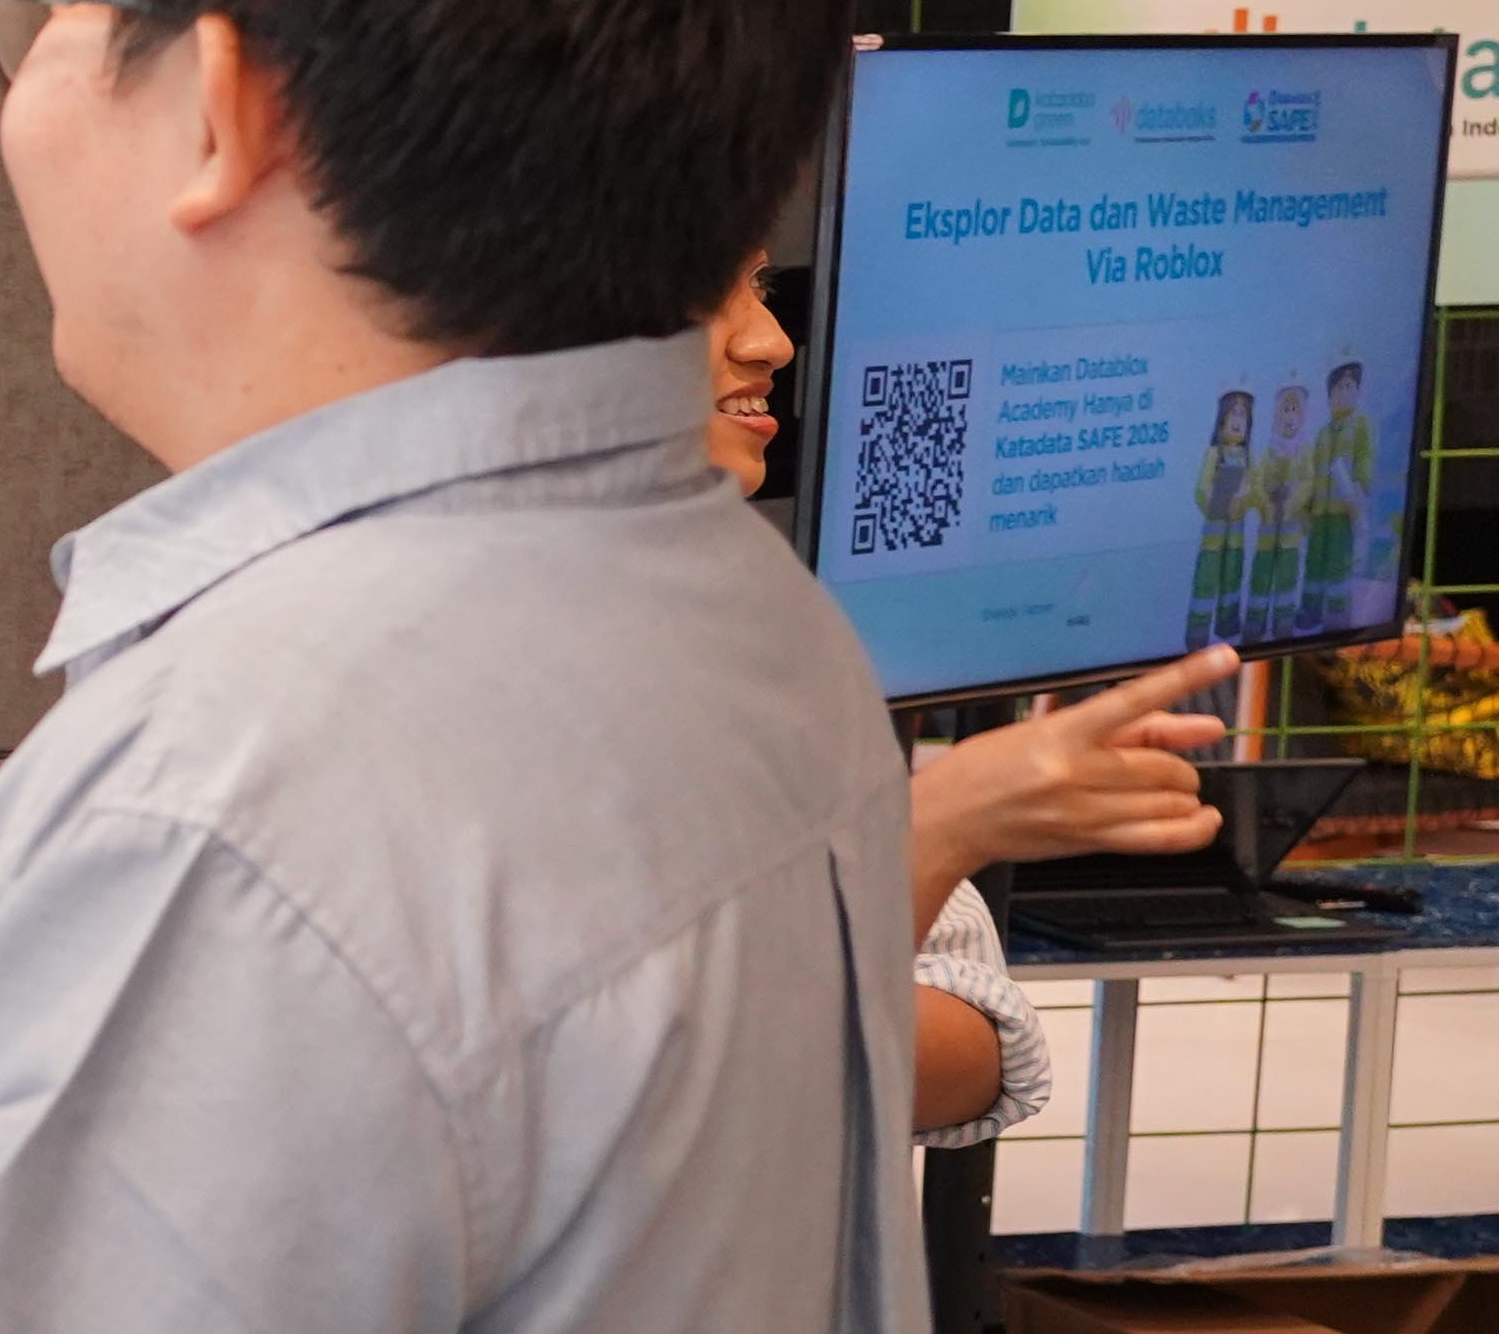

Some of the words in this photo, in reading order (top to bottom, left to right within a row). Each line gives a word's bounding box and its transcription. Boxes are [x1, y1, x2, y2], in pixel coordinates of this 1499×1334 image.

[1267, 108, 1311, 132] SAFE
[1462, 117, 1499, 137] Ind
[905, 198, 1011, 245] Eksplor
[1018, 197, 1080, 234] Data
[1090, 193, 1137, 231] dan
[1148, 191, 1226, 227] Waste
[1234, 185, 1389, 228] Management
[1087, 247, 1126, 284] Via
[1135, 243, 1223, 279] Roblox
[1001, 362, 1071, 386] Mainkan
[999, 398, 1078, 423] Academy
[1083, 392, 1133, 417] Hanya
[1138, 388, 1154, 410] di
[995, 431, 1072, 460] Katadata
[1078, 427, 1123, 450] SAFE
[1127, 421, 1169, 446] 2026
[991, 471, 1024, 496] dan
[1028, 464, 1106, 493] dapatkan
[1111, 458, 1165, 483] hadiah
[989, 504, 1058, 533] menarik
